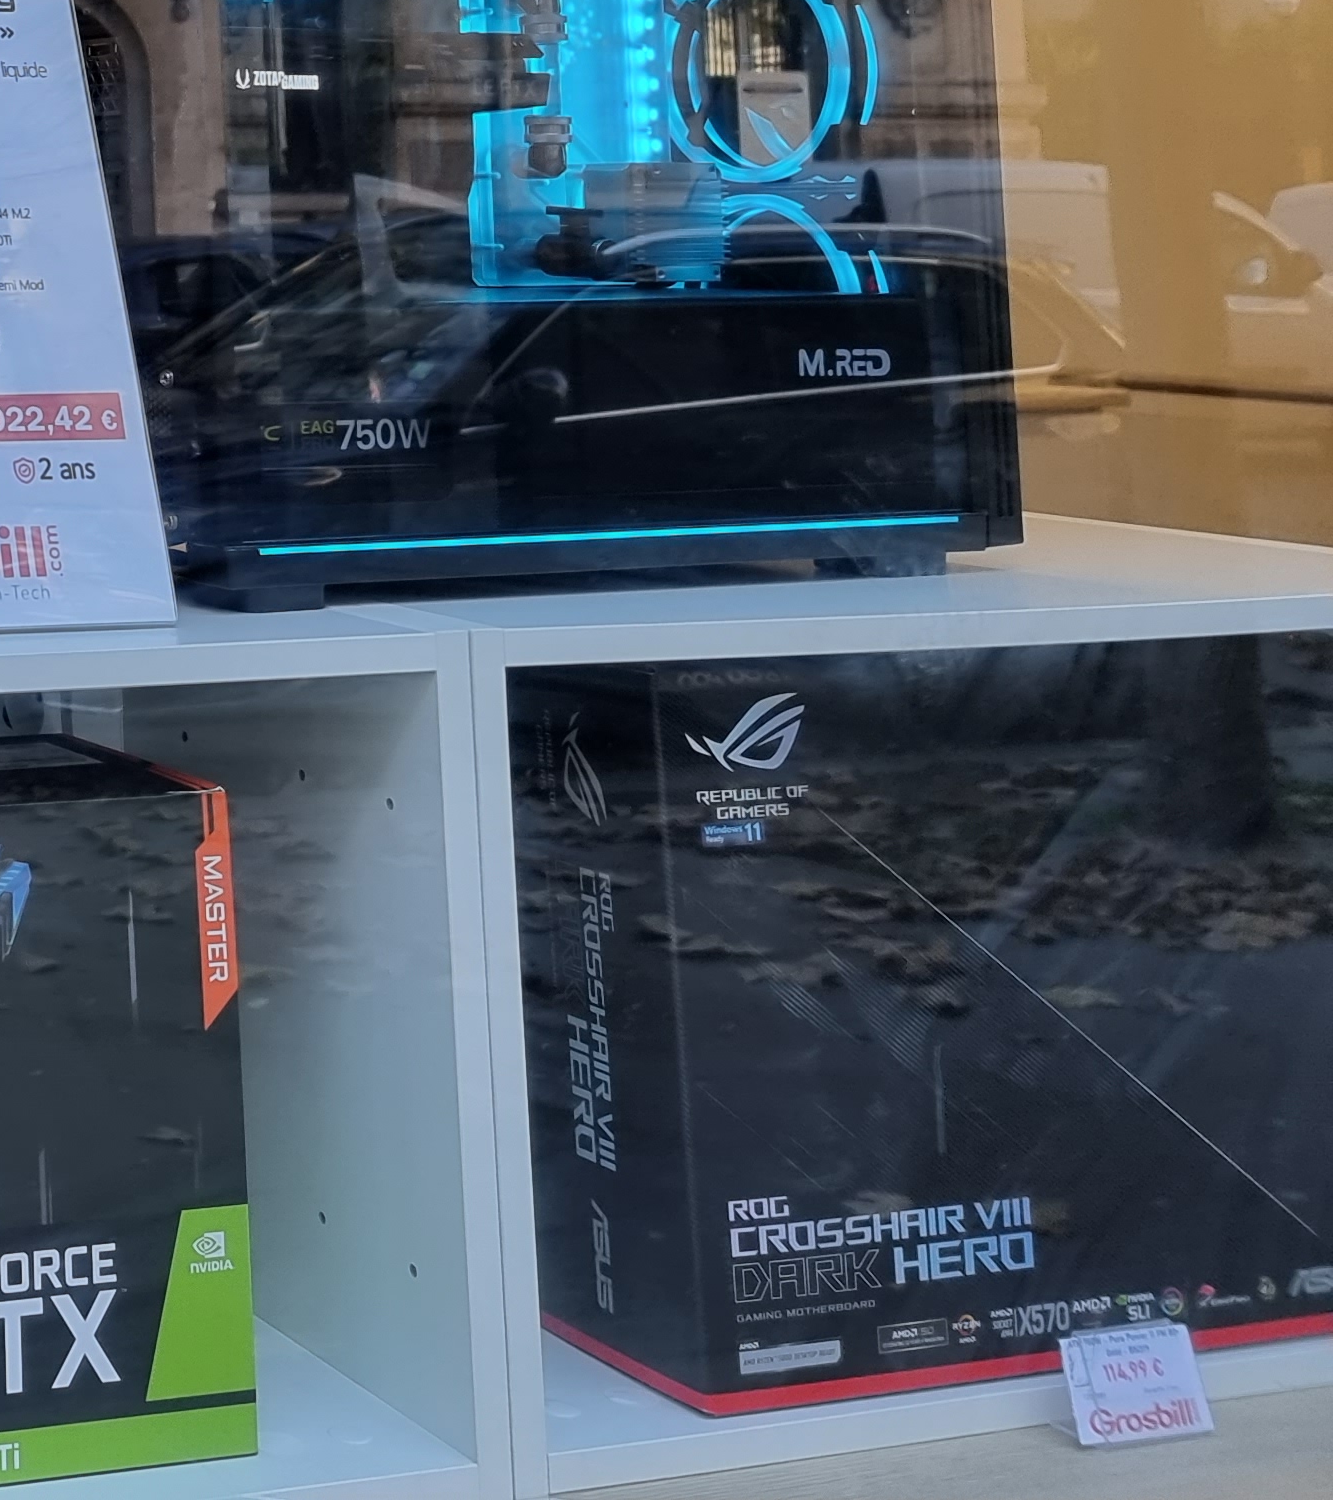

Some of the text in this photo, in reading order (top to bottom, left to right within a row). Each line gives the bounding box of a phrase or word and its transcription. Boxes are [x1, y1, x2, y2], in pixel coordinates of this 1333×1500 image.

[1, 61, 48, 82] liquide
[281, 75, 320, 90] GAMING
[798, 348, 891, 377] M.RED
[100, 408, 118, 431] €
[300, 419, 334, 435] EAG
[335, 418, 432, 450] 750W
[38, 457, 96, 480] 2 ans
[696, 785, 810, 806] REPUBLIC OF
[716, 803, 790, 820] GAMERS
[744, 821, 762, 842] 11
[598, 871, 615, 933] ROG
[202, 855, 229, 983] MASTER
[579, 865, 618, 1172] CROSSHAIR VIII
[567, 1013, 598, 1164] HERO
[727, 1195, 791, 1222] ROG
[729, 1196, 1032, 1259] CROSSHAIR VIII
[732, 1230, 1035, 1304] DARK HERO
[736, 1299, 877, 1324] GAMING MOTHERBOARD
[1017, 1301, 1071, 1337] X570
[1127, 1304, 1152, 1321] SLI
